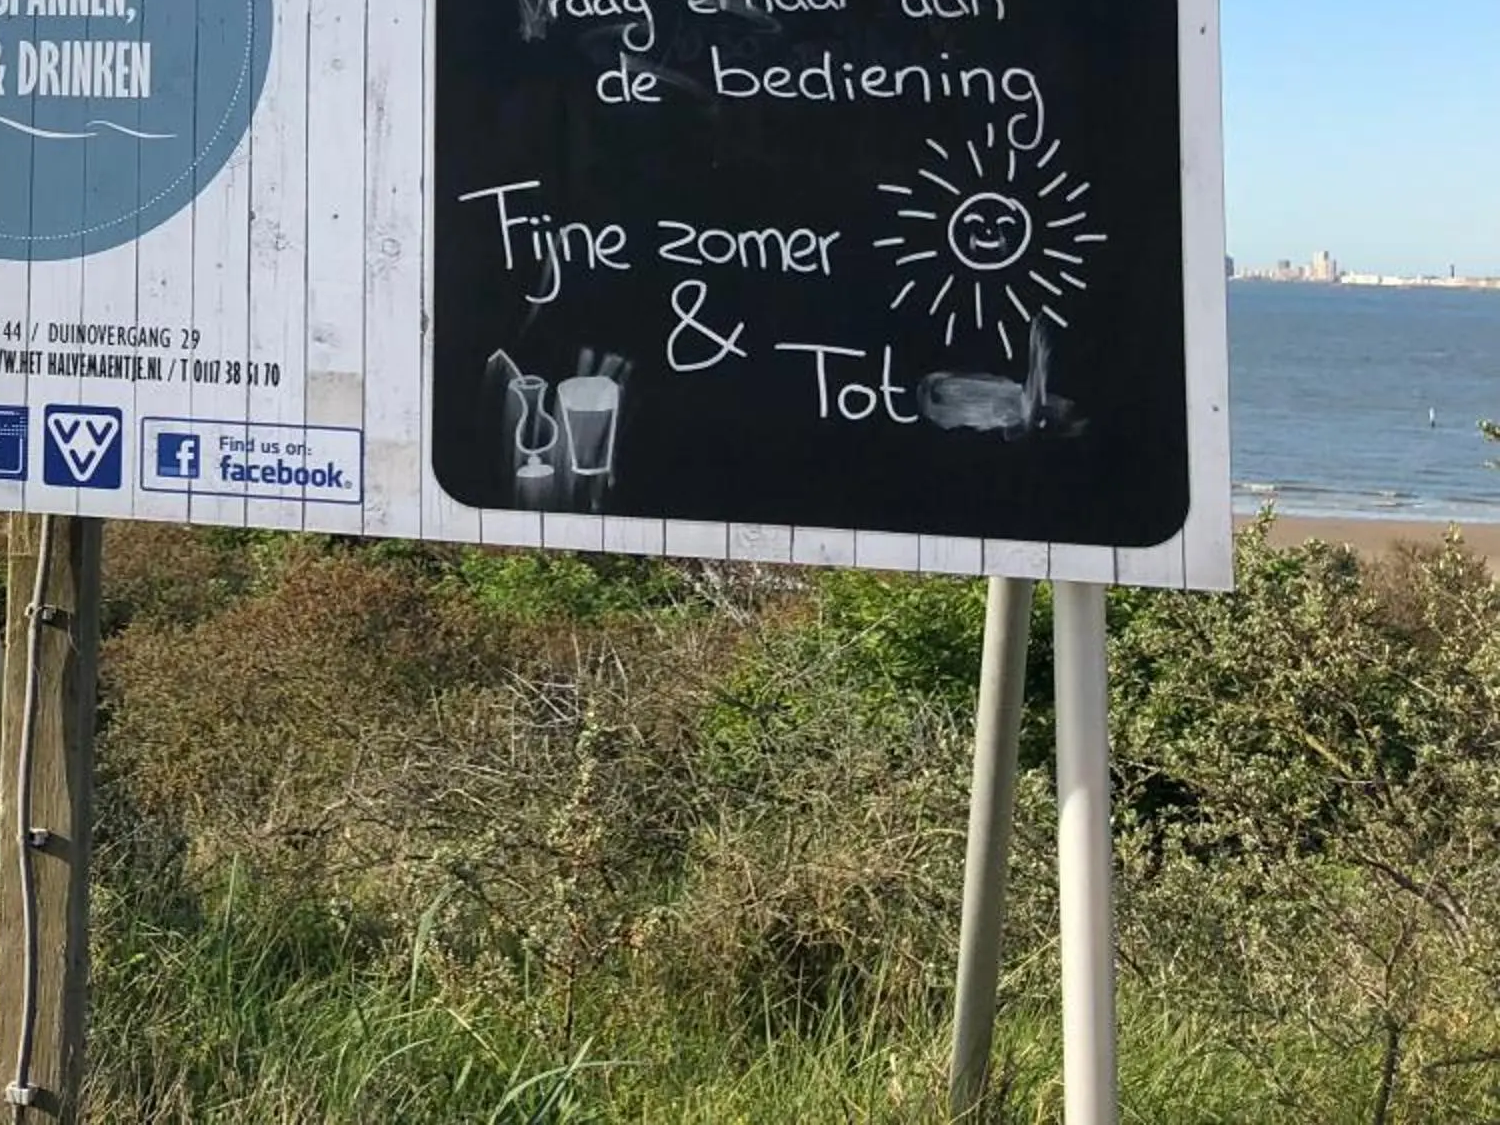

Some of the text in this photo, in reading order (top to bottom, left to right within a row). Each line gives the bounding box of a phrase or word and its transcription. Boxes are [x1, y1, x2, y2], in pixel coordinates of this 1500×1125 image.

[17, 40, 151, 98] DRINKEN
[597, 46, 1045, 150] de bediening
[458, 181, 840, 303] Fijne zomer
[3, 321, 22, 341] 44
[48, 323, 171, 349] DUINOVERGANG
[181, 328, 200, 350] 29
[666, 279, 748, 372] &
[225, 361, 241, 384] 38
[264, 363, 280, 387] 70
[774, 344, 919, 422] Tot
[219, 436, 312, 456] Find us on:
